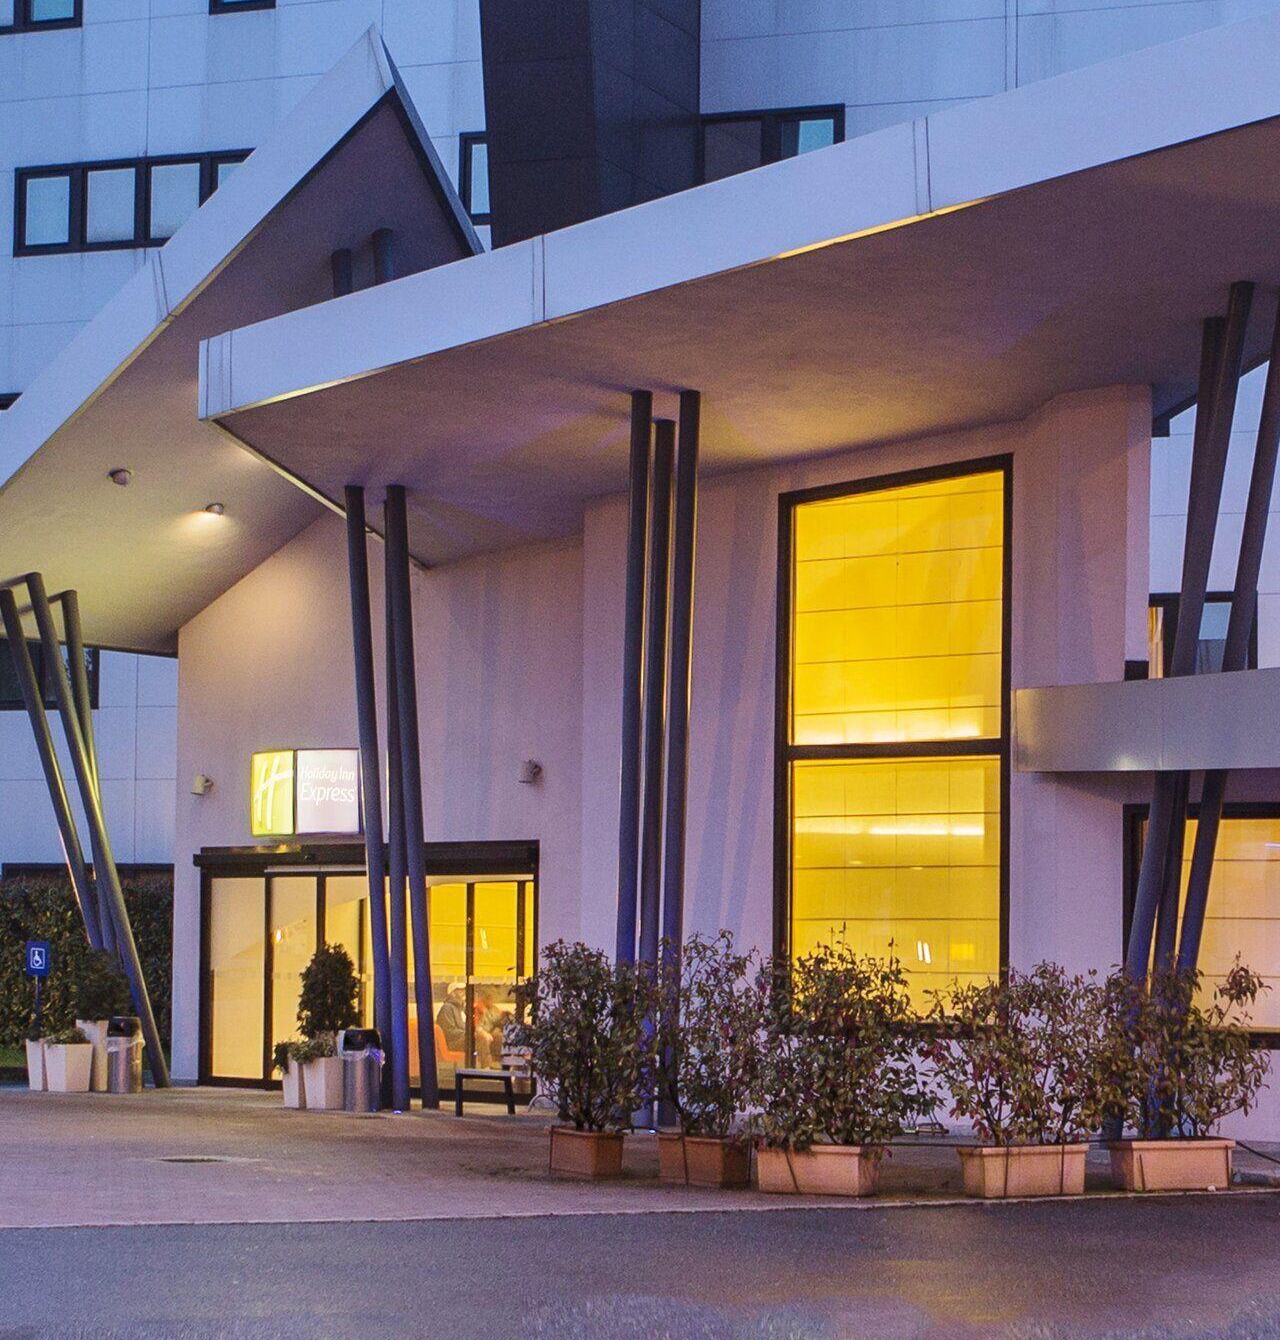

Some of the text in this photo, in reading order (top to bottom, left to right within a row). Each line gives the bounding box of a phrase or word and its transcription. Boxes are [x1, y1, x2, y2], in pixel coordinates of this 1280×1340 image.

[301, 764, 355, 782] Holiday Inn
[301, 783, 356, 806] Express
